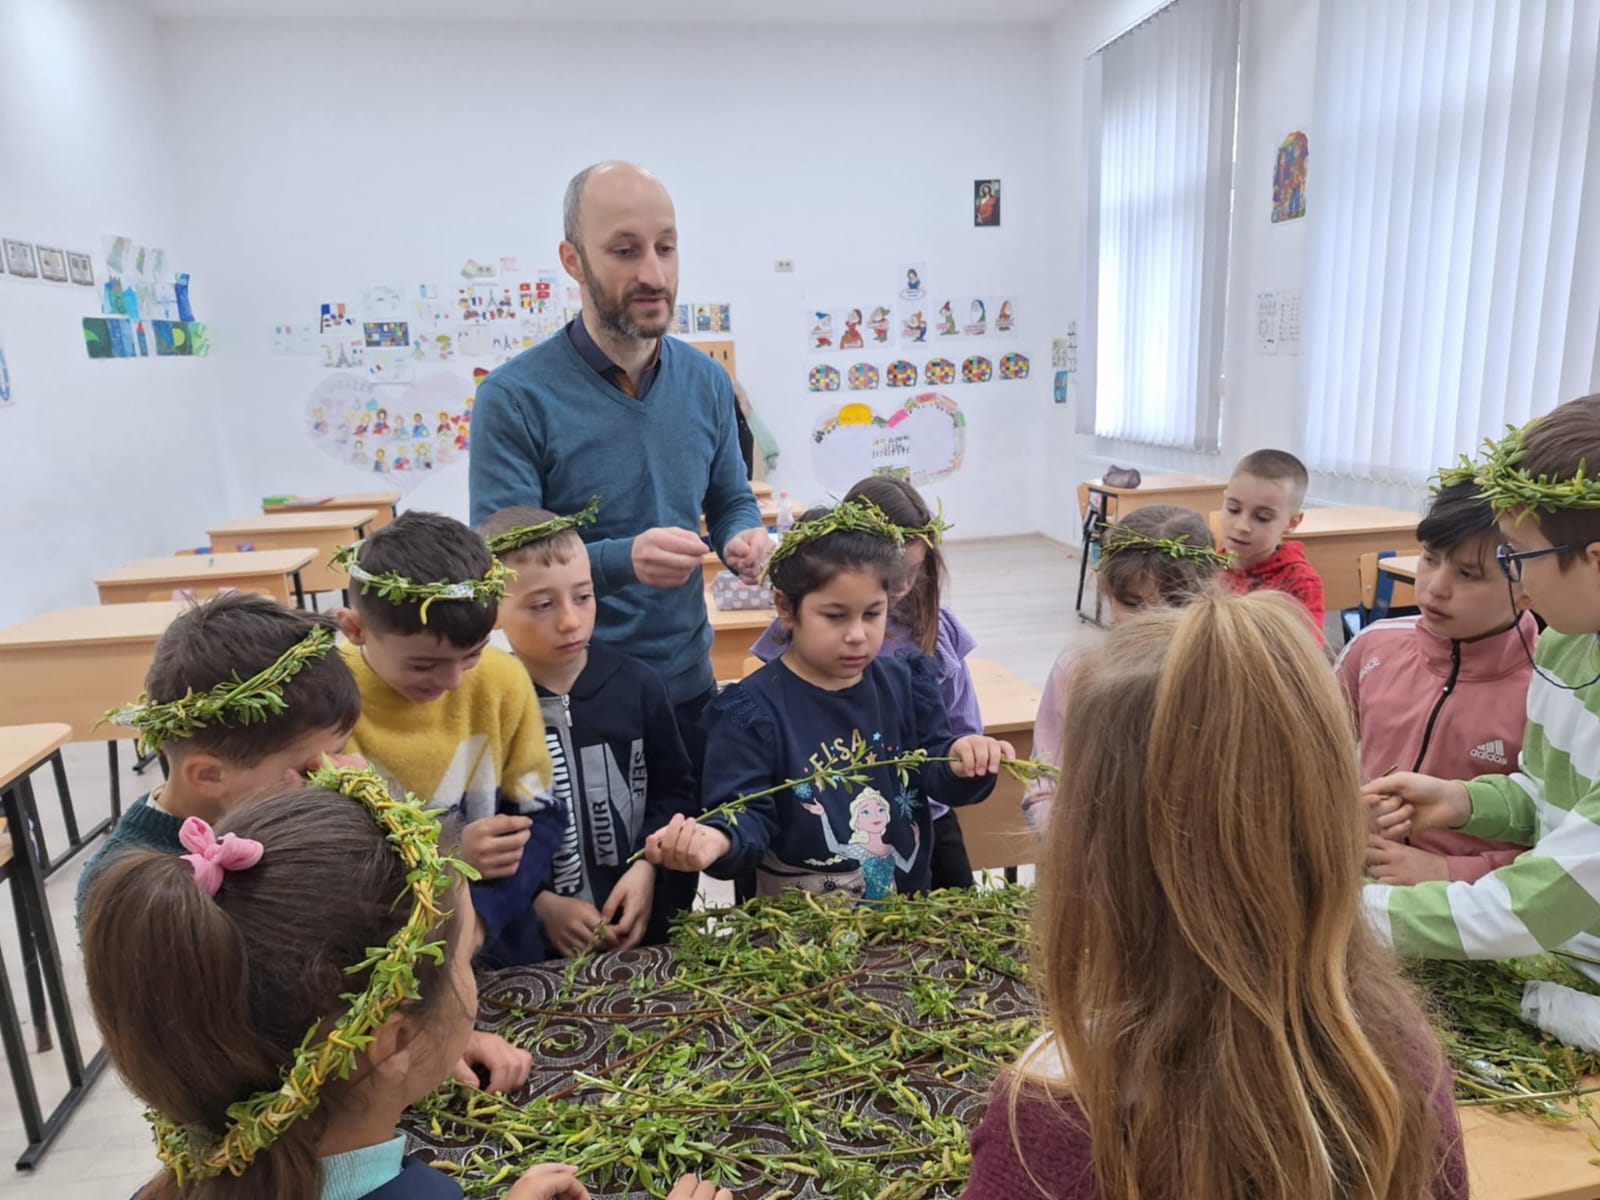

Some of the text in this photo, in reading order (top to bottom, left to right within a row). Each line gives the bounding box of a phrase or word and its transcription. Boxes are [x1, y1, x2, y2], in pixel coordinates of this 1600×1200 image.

[809, 729, 862, 773] ELSA
[1470, 748, 1508, 765] adidas
[632, 751, 645, 799] SELF
[593, 801, 614, 858] YOUR
